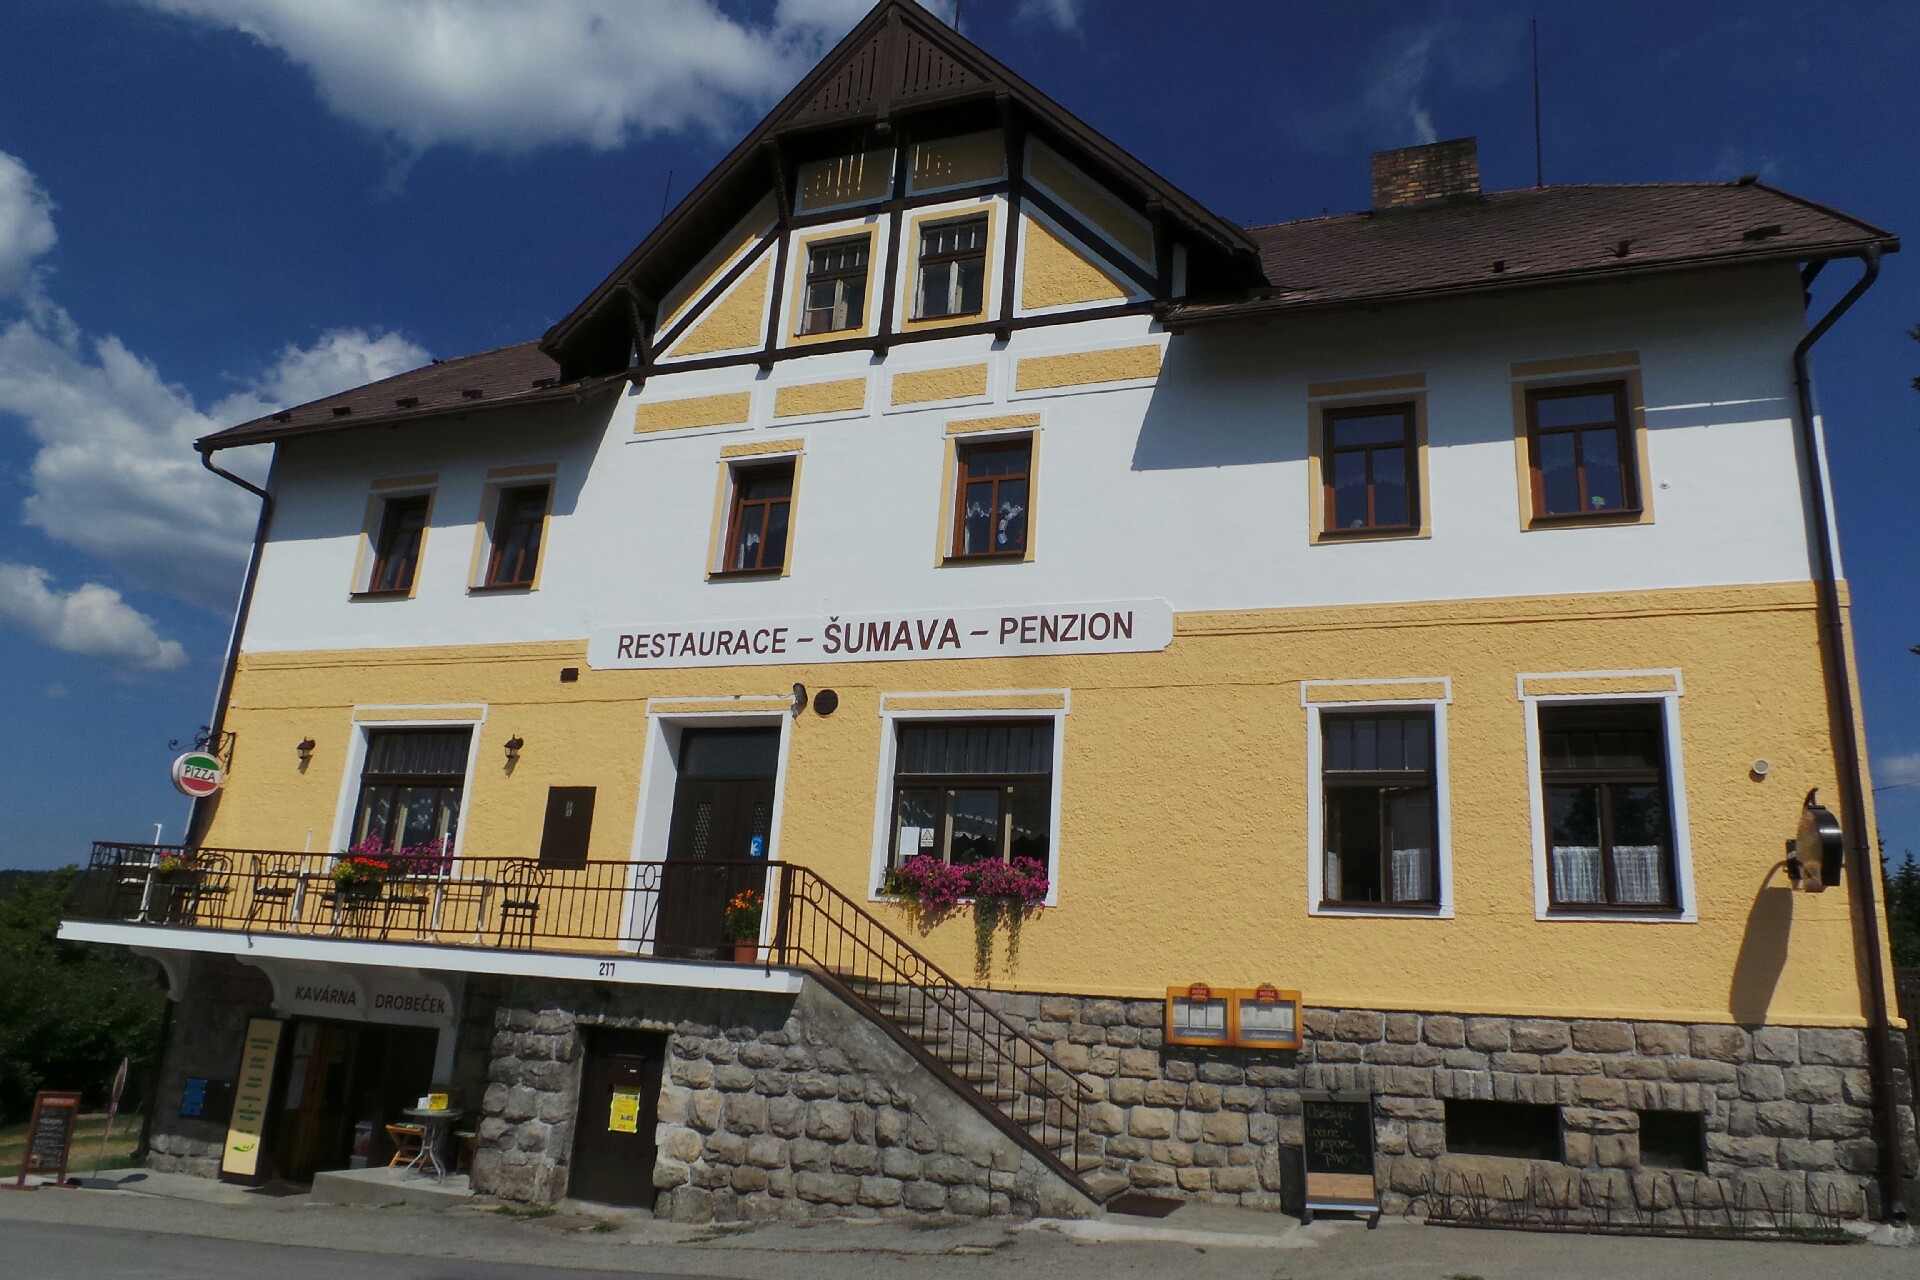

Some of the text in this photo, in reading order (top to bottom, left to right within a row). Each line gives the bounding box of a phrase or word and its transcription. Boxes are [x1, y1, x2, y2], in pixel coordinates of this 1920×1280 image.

[617, 627, 789, 660] RESTAURACE
[822, 615, 962, 654] ŠUMAVA
[999, 610, 1134, 645] PENZION
[184, 765, 216, 783] PIZZA
[599, 961, 616, 977] 217
[295, 985, 357, 1006] KAVÁRNA
[374, 993, 445, 1014] DROBEČEK
